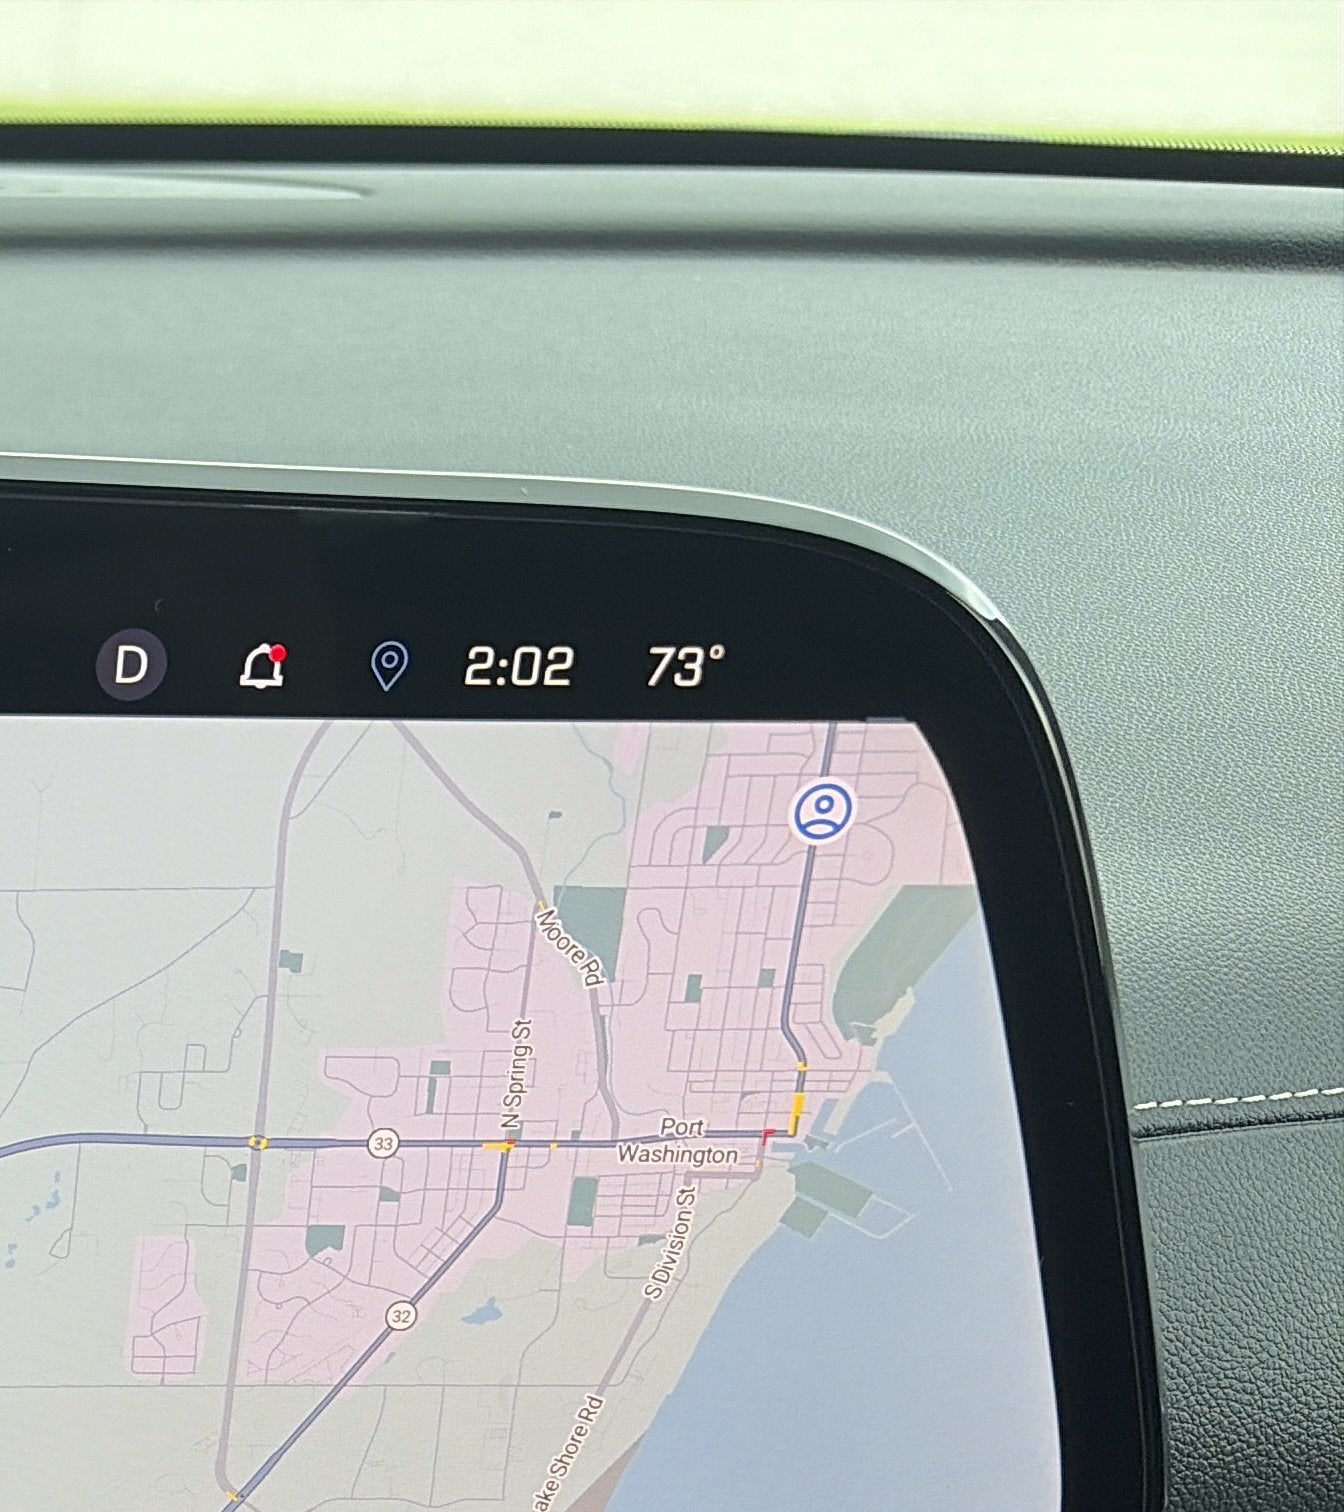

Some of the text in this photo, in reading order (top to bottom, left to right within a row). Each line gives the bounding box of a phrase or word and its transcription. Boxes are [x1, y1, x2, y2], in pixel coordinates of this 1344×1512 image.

[114, 644, 148, 683] D
[464, 645, 575, 686] 2:02
[646, 644, 726, 687] 73°
[537, 909, 604, 987] Moore Rd
[500, 1020, 532, 1128] N Spring St
[374, 1137, 393, 1150] 33
[661, 1117, 704, 1136] Port
[618, 1145, 738, 1167] Washington
[644, 1186, 695, 1300] S Division St
[392, 1310, 411, 1323] 32
[549, 1424, 588, 1479] Shore
[577, 1395, 604, 1424] Rd
